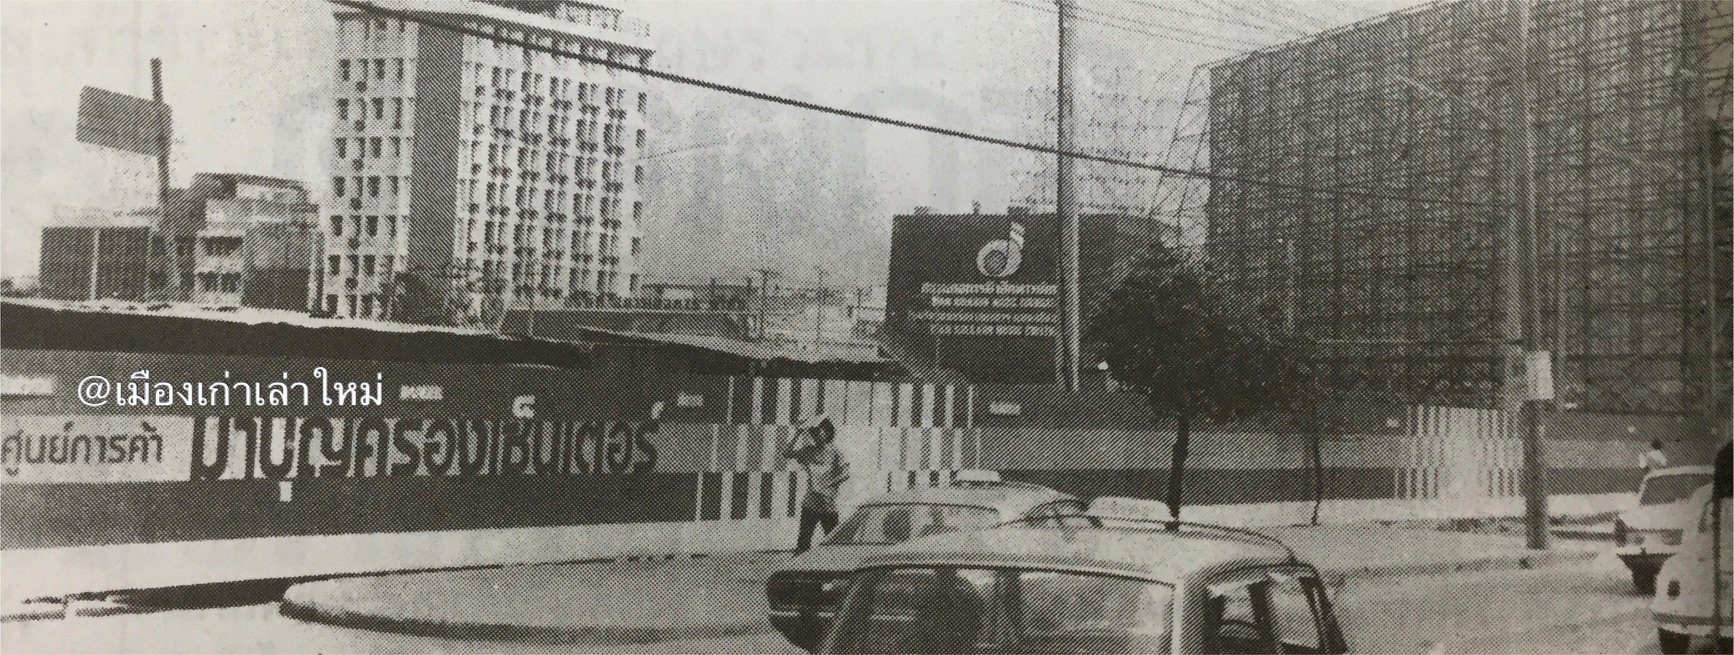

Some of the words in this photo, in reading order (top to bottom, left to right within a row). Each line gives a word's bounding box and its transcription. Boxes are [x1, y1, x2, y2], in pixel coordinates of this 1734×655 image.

[1, 420, 164, 477] ศูนย์การค้า
[191, 395, 665, 502] มาบุญครองเซ็นเตอร์
